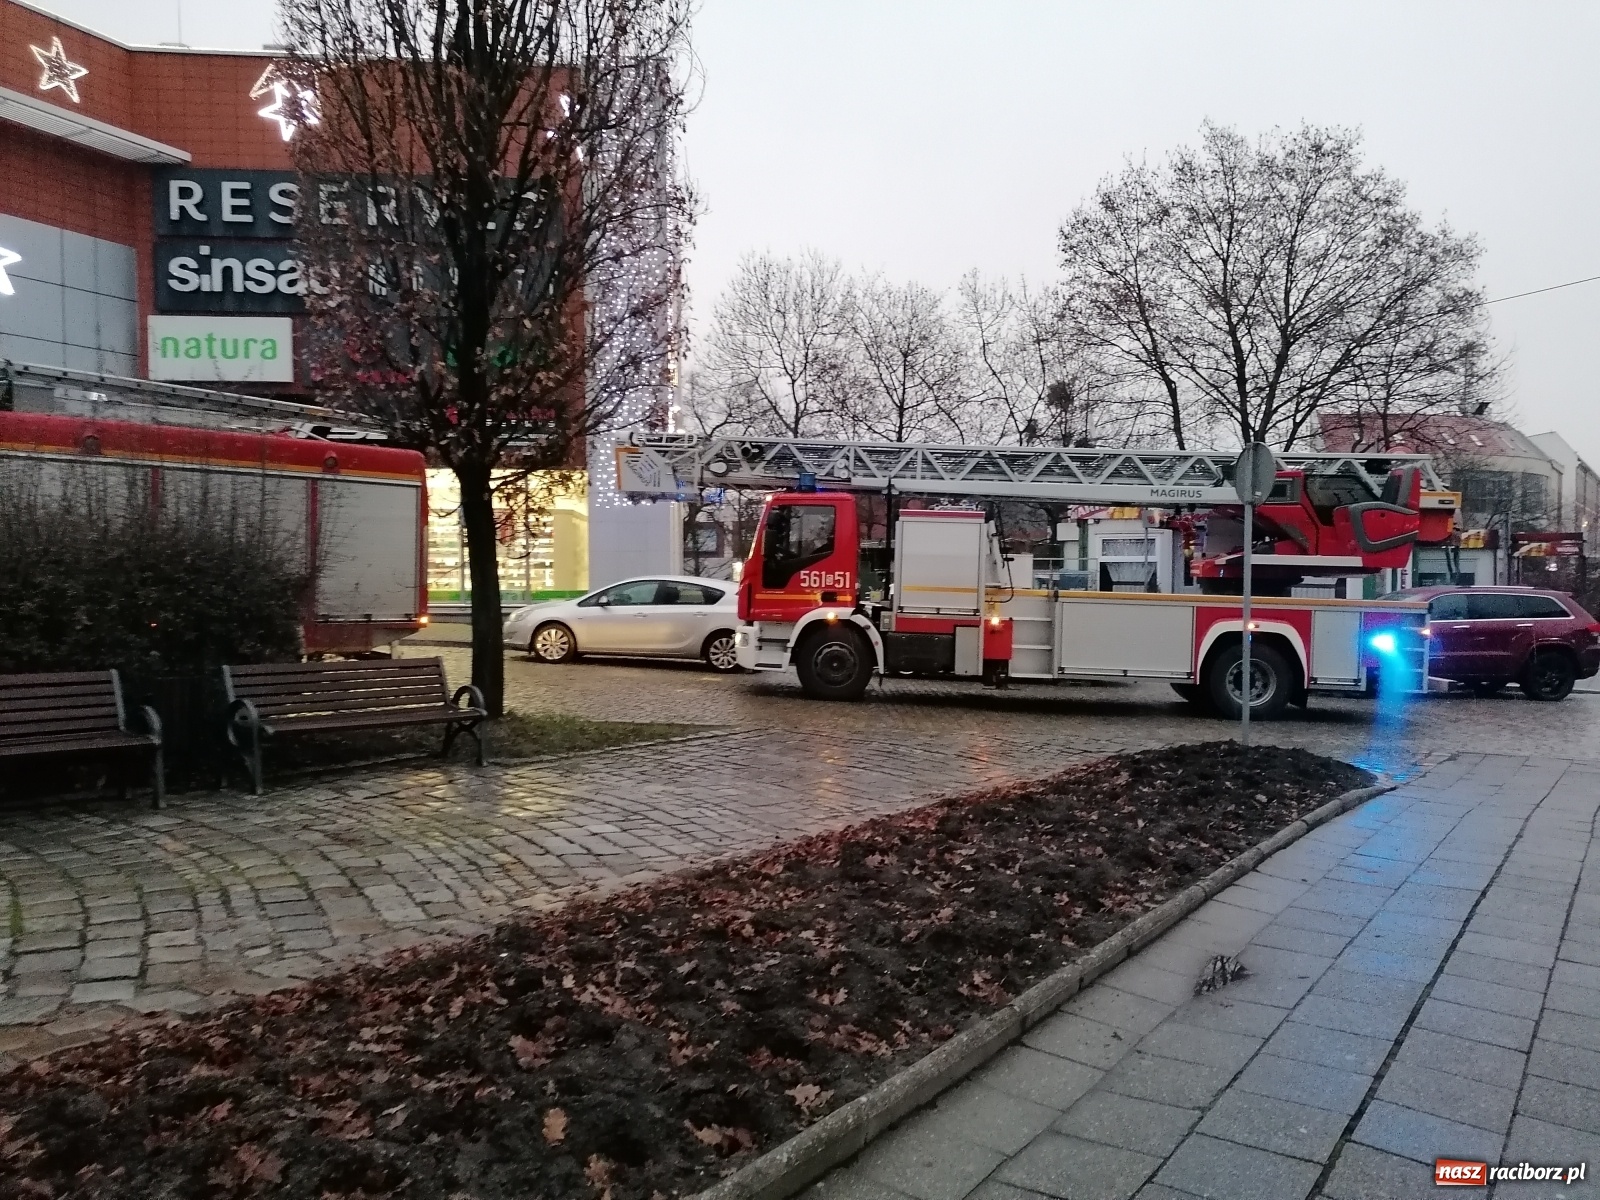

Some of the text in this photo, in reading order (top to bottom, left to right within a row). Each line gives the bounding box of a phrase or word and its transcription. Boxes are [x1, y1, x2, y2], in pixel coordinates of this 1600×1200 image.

[168, 179, 550, 231] RESERV
[160, 332, 277, 360] natura
[1150, 488, 1203, 499] MAGIRUS
